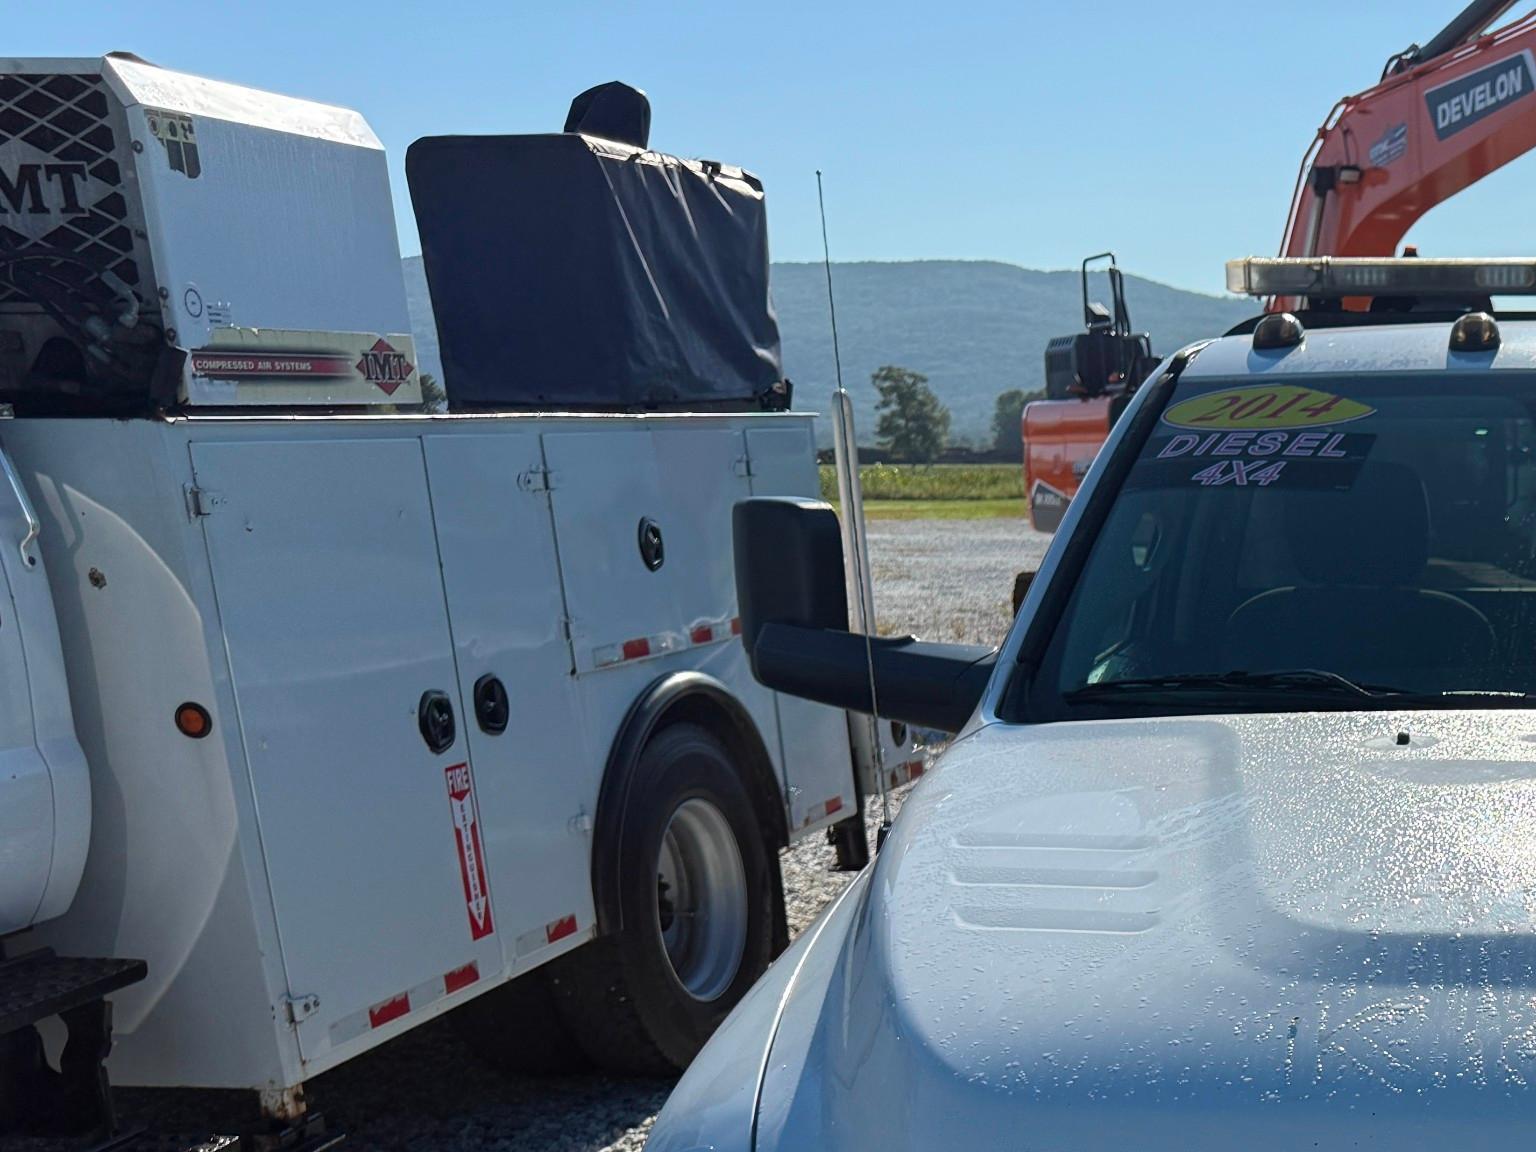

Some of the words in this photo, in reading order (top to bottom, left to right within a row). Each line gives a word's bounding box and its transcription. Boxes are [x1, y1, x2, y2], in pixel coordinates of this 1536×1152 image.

[1437, 66, 1523, 130] DEVELON
[196, 360, 254, 371] COMPRESSED
[258, 361, 272, 371] AIR
[275, 361, 312, 371] SYSTEMS
[361, 353, 408, 381] IMT
[1188, 392, 1342, 423] 2014
[1156, 431, 1348, 459] DIESEL
[1191, 460, 1288, 486] 4X4
[447, 767, 470, 794] FIRE
